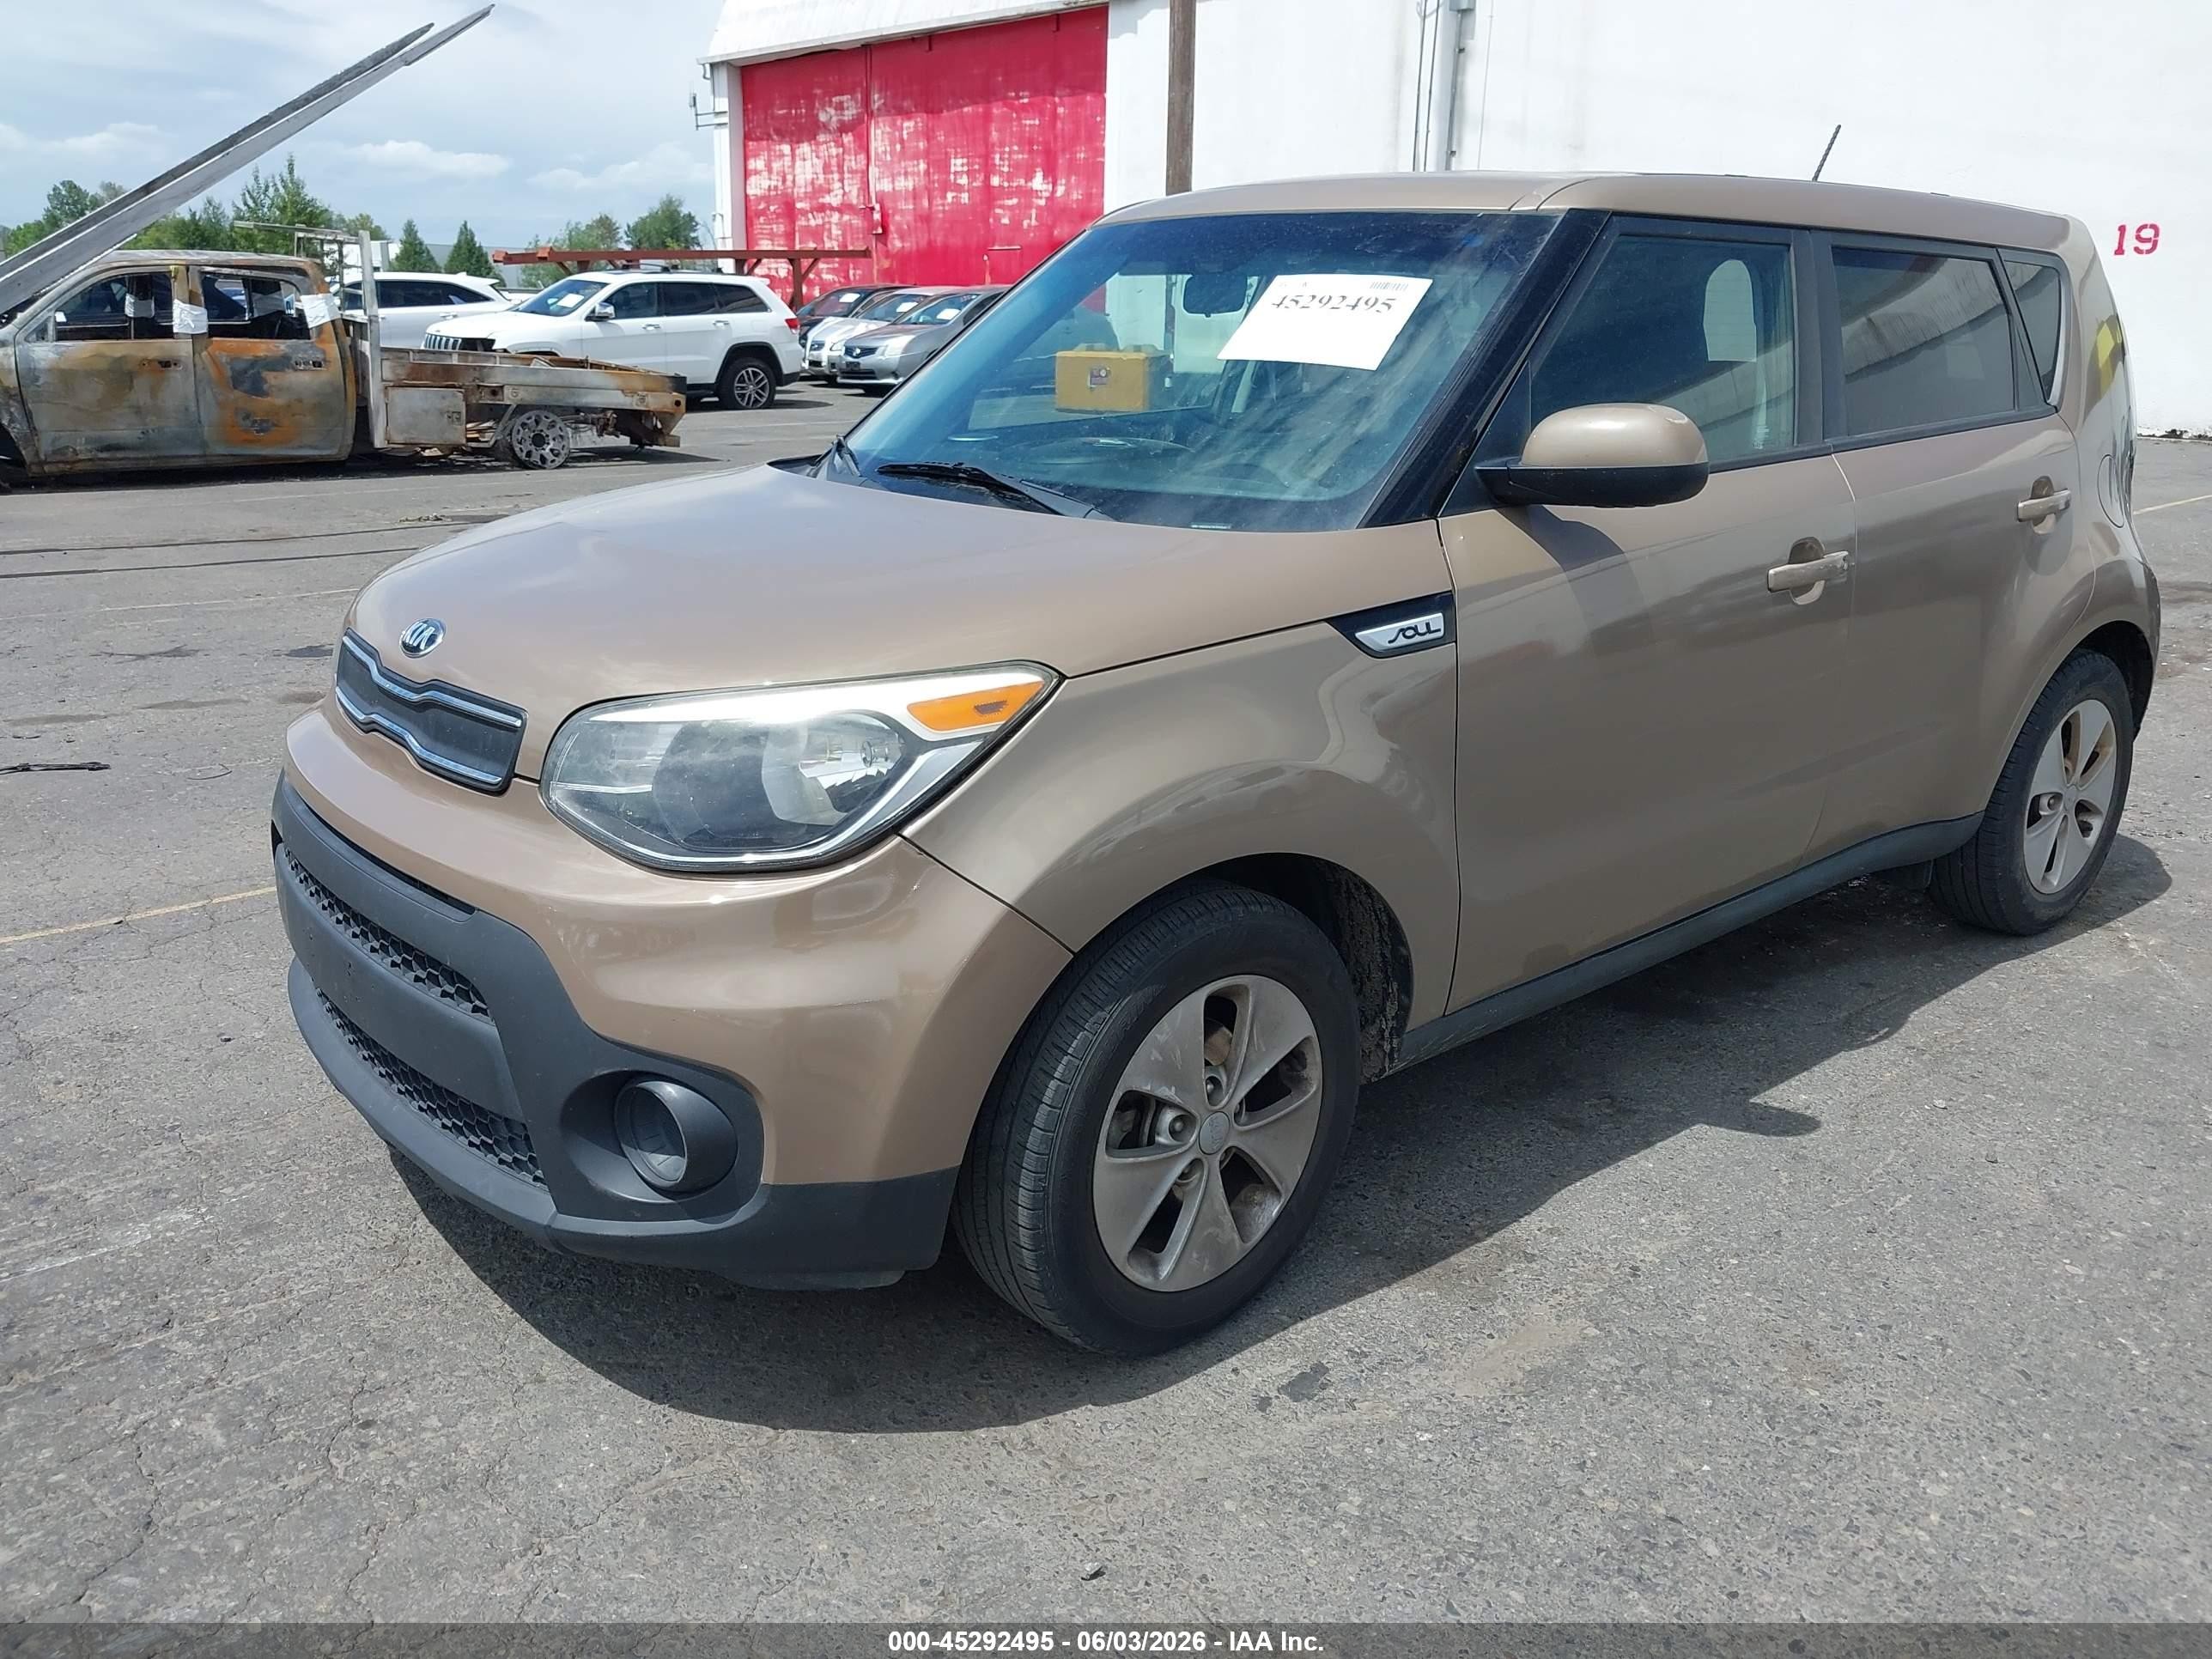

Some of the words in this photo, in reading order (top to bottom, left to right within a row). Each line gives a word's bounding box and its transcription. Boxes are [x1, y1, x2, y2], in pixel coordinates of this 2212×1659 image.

[2114, 223, 2160, 255] 19
[1271, 294, 1396, 313] 45292495
[1388, 622, 1441, 643] SOUL
